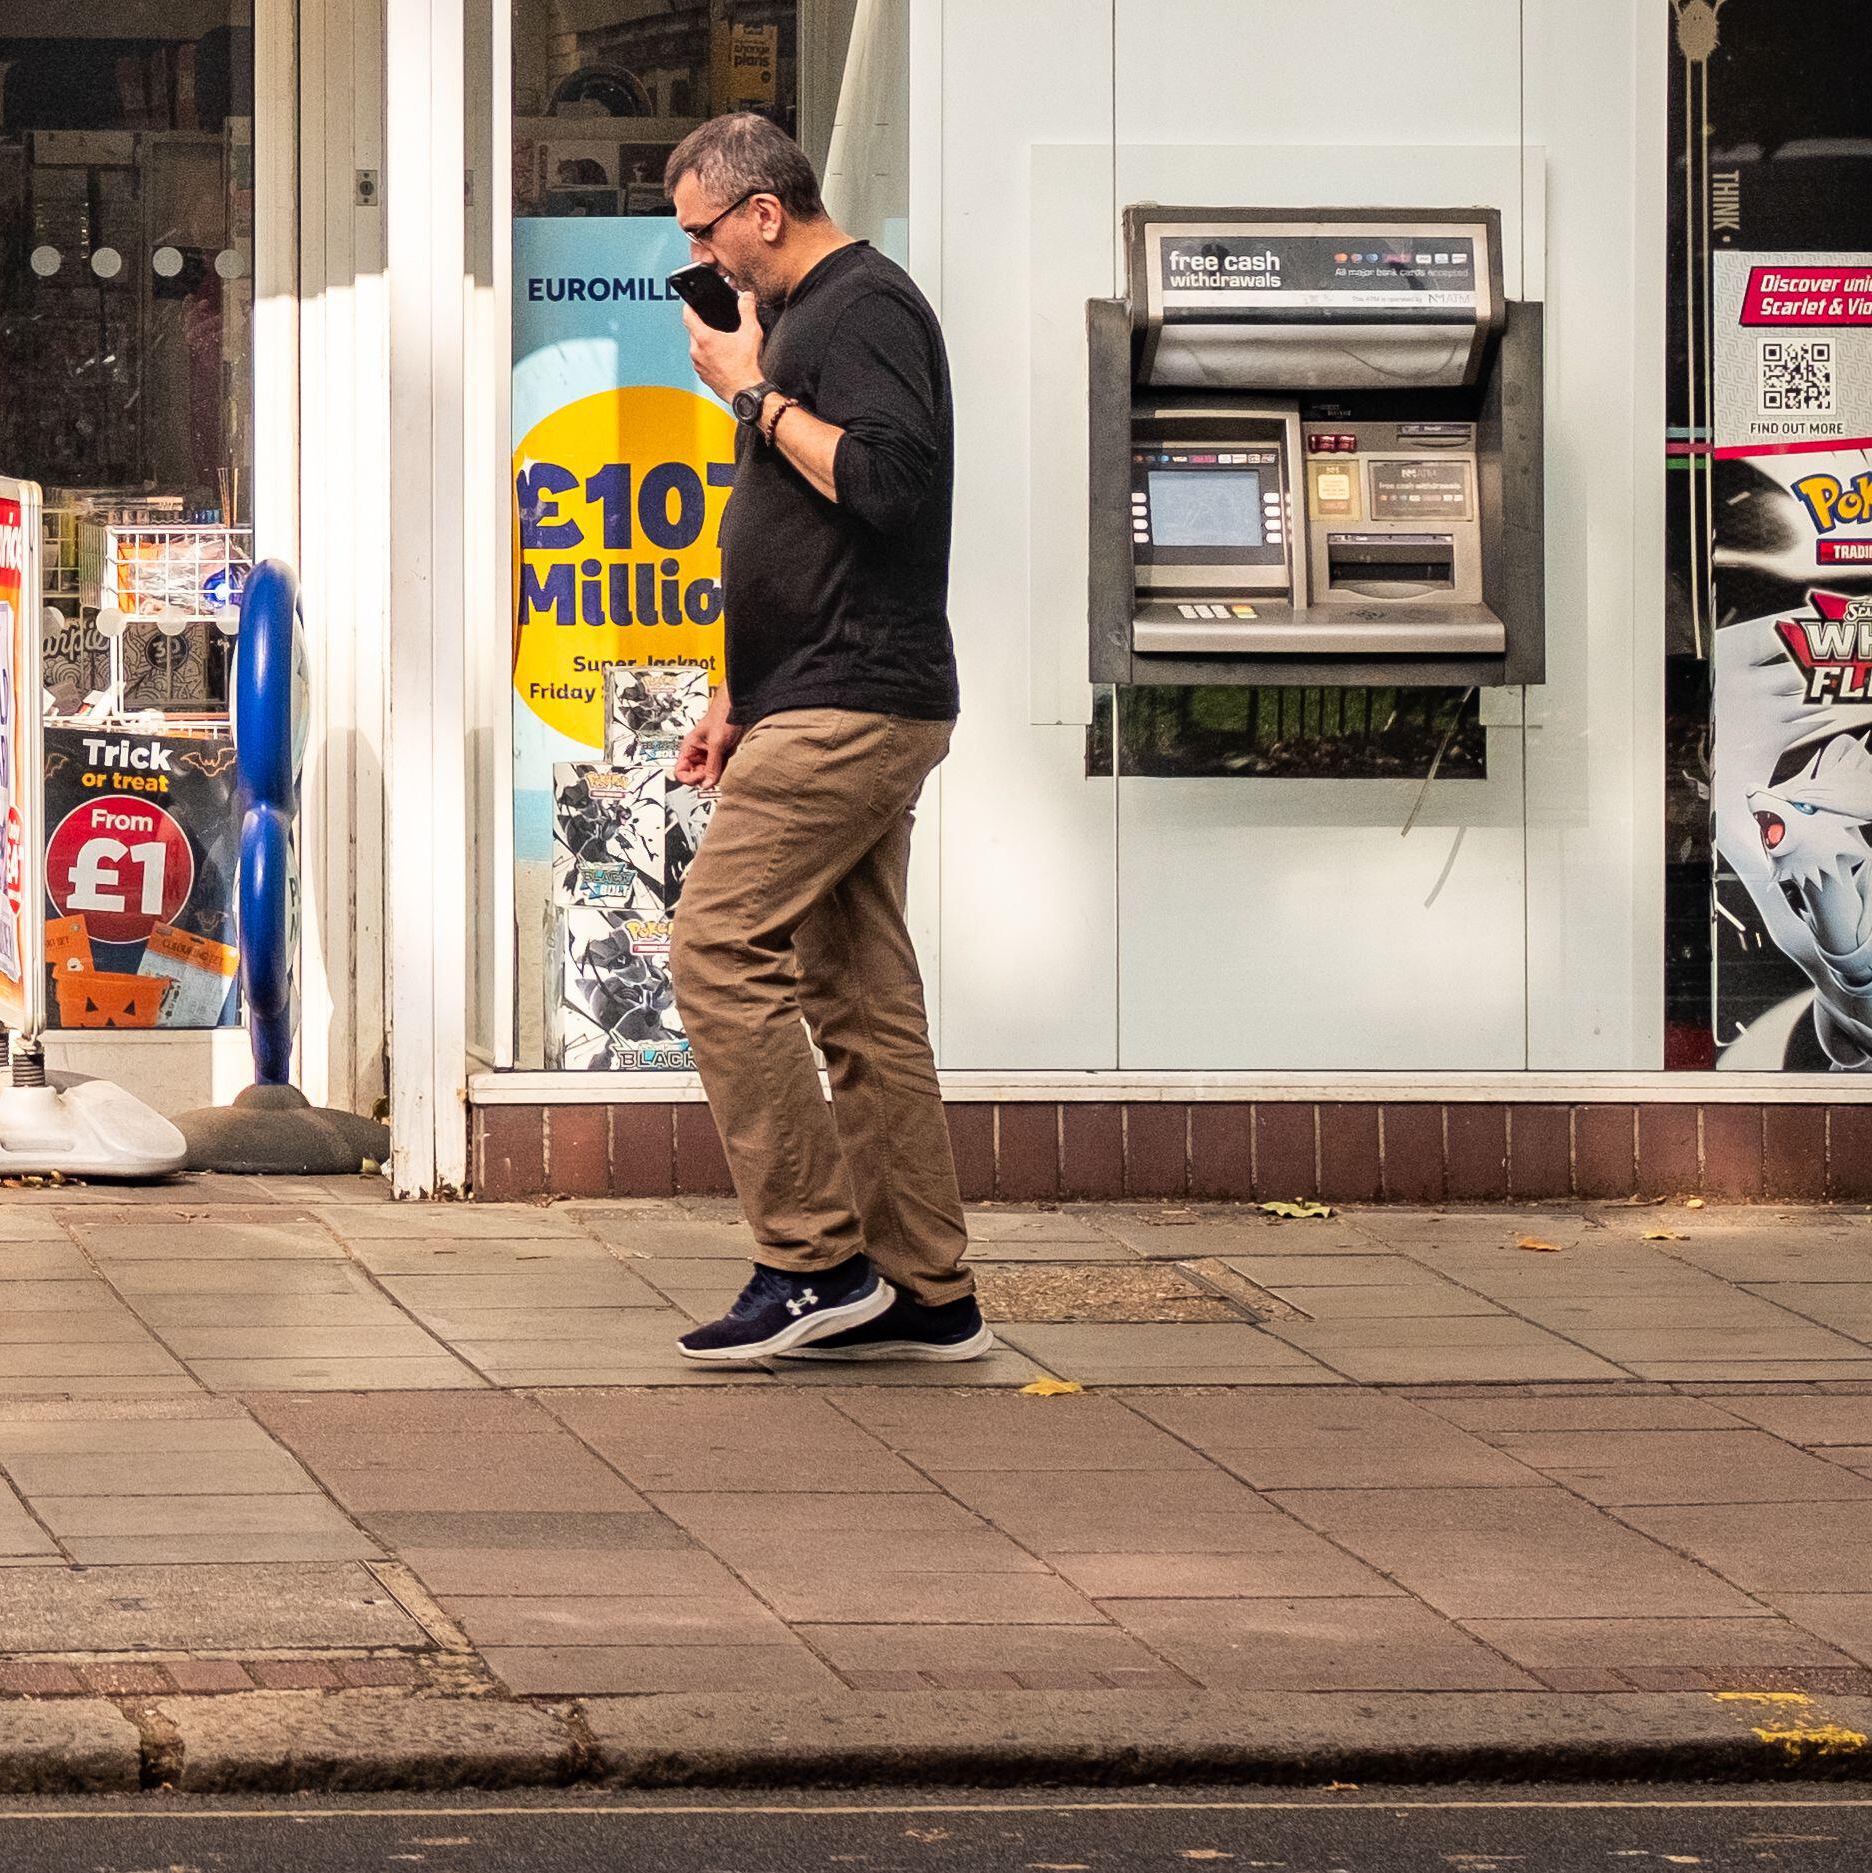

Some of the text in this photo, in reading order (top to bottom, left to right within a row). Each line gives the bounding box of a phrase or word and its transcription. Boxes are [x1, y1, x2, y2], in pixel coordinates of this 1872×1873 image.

[1713, 170, 1740, 230] THINK
[1169, 251, 1281, 271] free cash
[528, 277, 680, 301] EUROMILL
[1170, 272, 1282, 288] withdrawals
[1760, 274, 1841, 293] Discover
[1760, 298, 1843, 316] Scarlet &
[1750, 423, 1844, 434] FIND OUT MORE
[518, 559, 724, 626] Millio
[529, 683, 596, 704] Friday
[83, 739, 174, 771] Trick
[81, 771, 169, 793] or treat
[91, 809, 154, 832] From
[66, 837, 167, 915] £1
